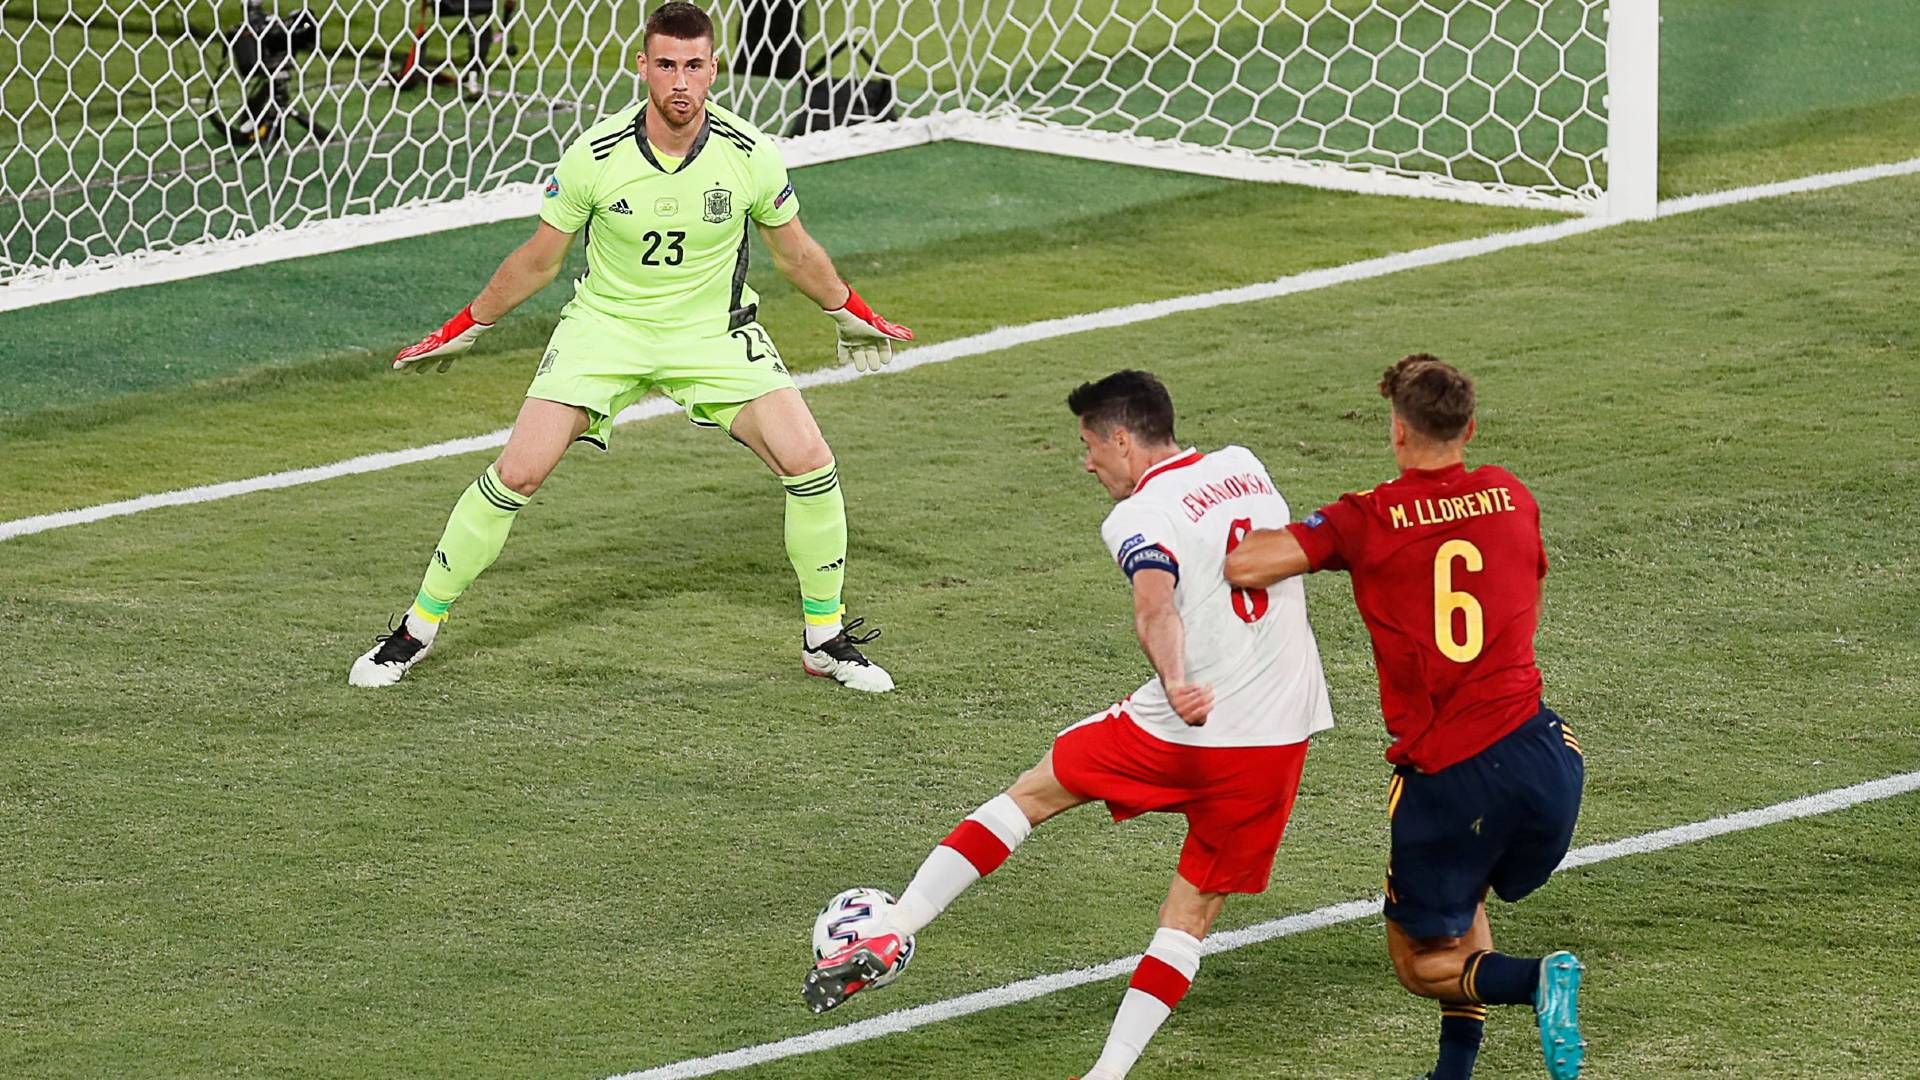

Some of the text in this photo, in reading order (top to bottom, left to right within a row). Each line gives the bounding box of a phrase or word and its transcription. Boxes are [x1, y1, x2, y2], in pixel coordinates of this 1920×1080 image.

[641, 231, 686, 266] 23
[1182, 473, 1273, 523] LEWANOWSKI
[1389, 487, 1516, 529] M. LLORENTE
[1434, 538, 1484, 663] 6
